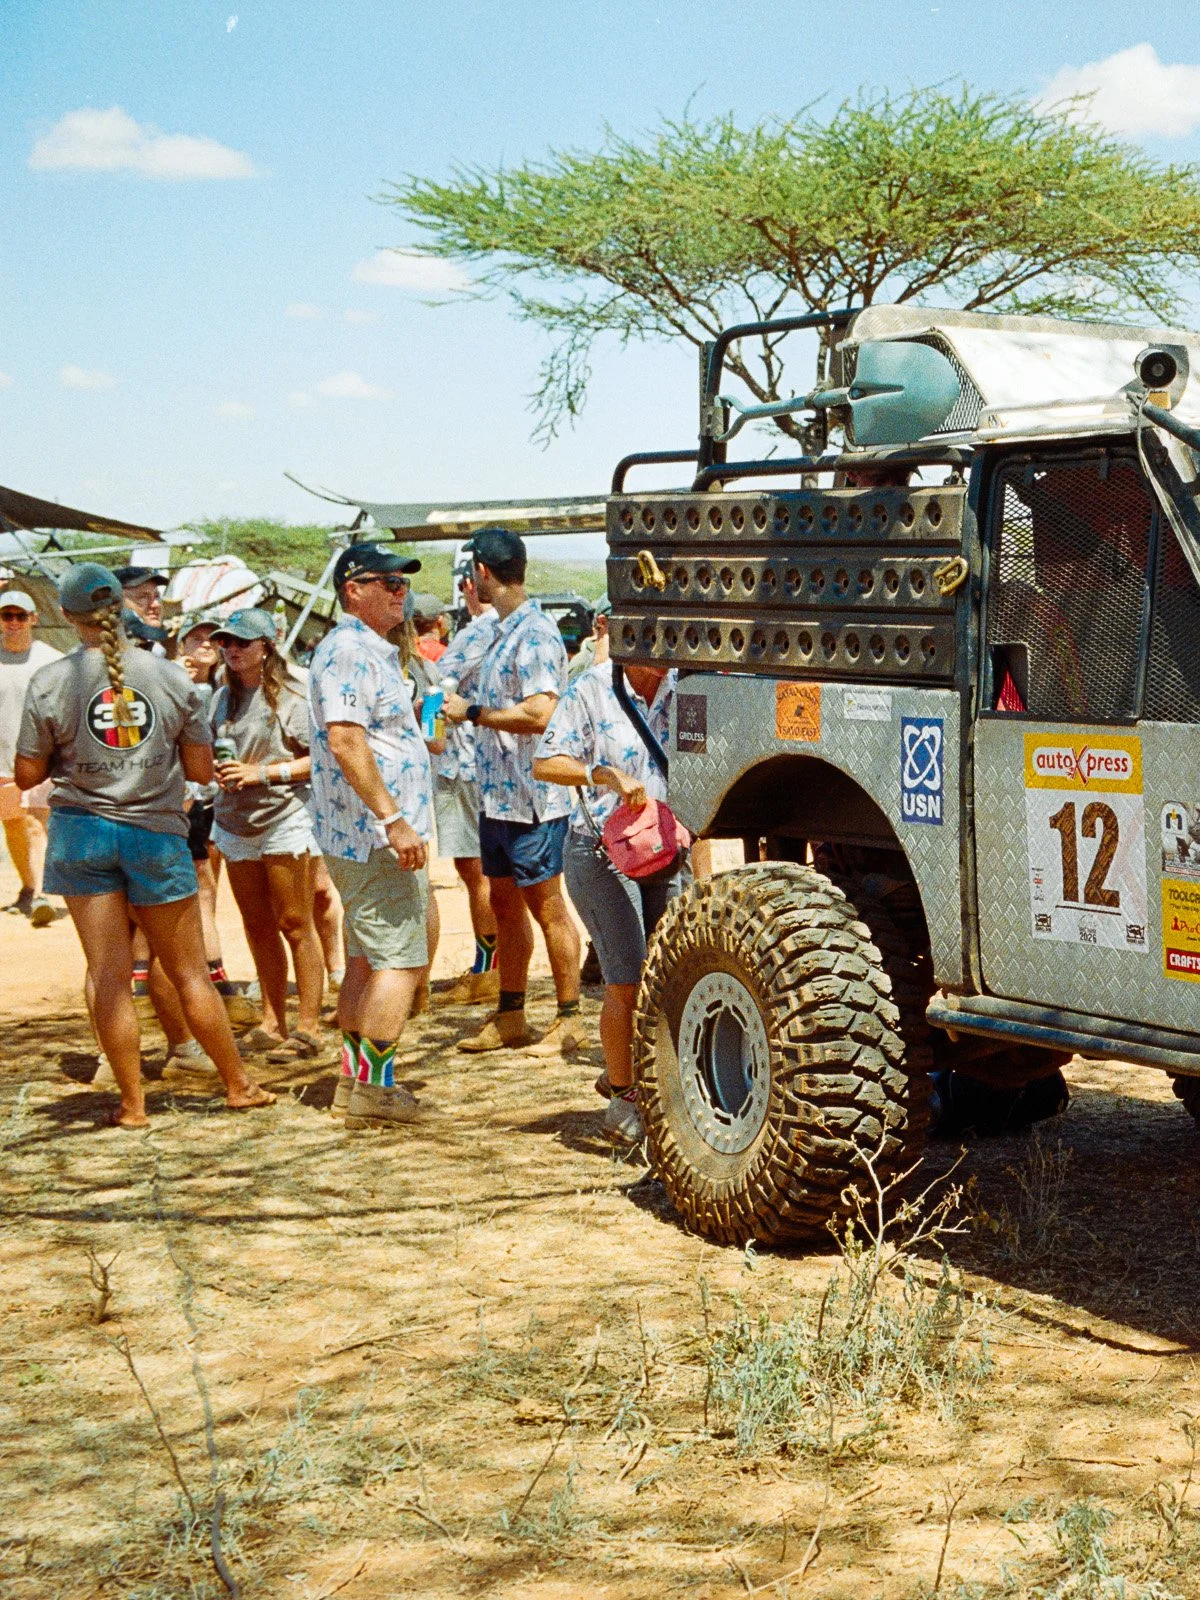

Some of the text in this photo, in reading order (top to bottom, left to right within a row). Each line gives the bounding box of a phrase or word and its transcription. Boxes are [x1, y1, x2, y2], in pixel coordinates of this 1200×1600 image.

[341, 693, 357, 707] 12
[678, 731, 705, 742] GRIDLESS
[76, 760, 125, 774] TEAM
[902, 793, 941, 819] USN
[1049, 802, 1120, 908] 12
[1079, 932, 1097, 944] 2026
